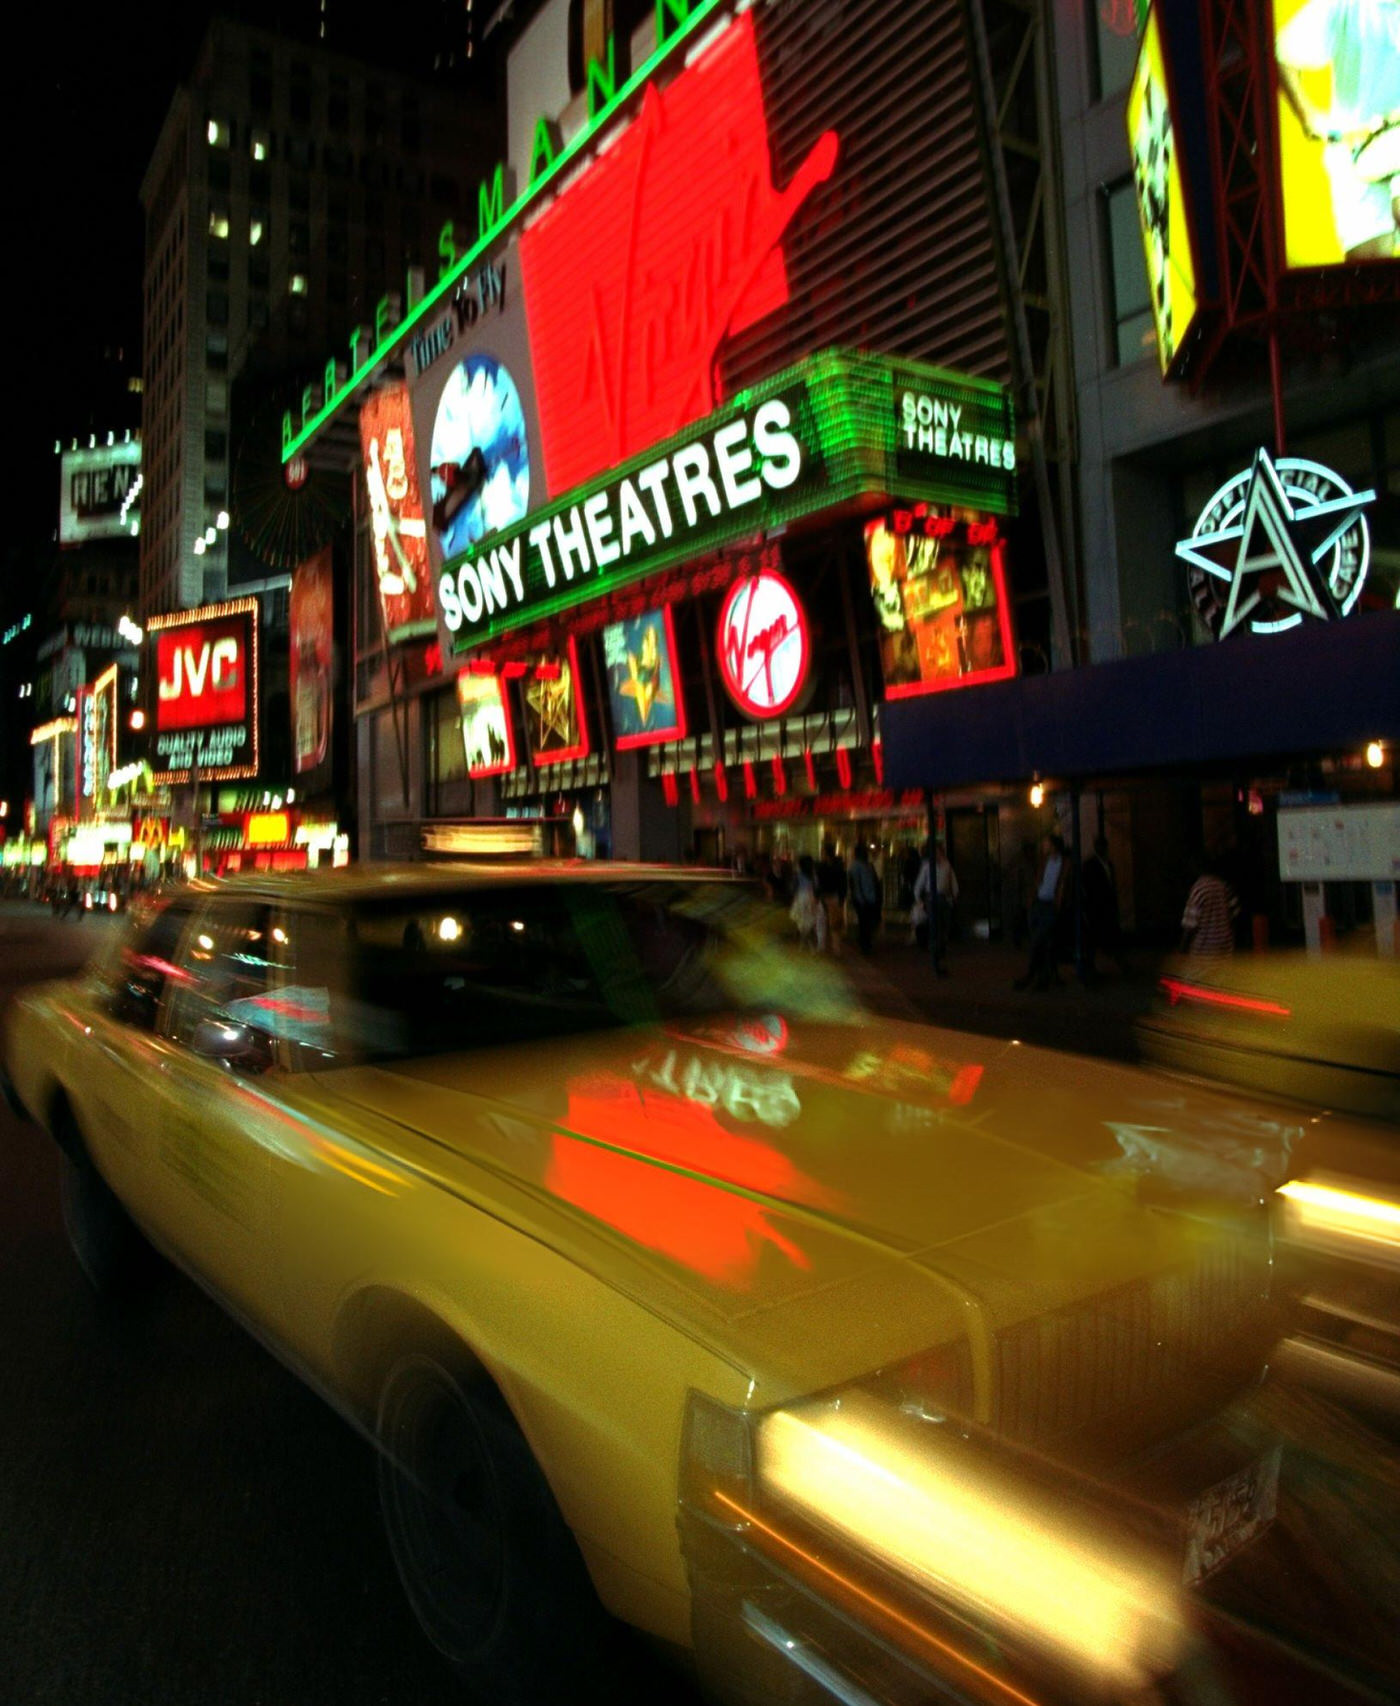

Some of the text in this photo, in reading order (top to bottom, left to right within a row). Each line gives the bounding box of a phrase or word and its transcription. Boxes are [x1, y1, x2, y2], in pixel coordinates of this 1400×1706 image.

[904, 391, 962, 428] SONY
[904, 424, 1016, 471] THEATRES
[438, 537, 525, 632] SONY
[529, 400, 801, 589] THEATRES
[728, 576, 799, 705] Virgin
[158, 636, 238, 701] JVC
[157, 725, 247, 758] QUALITY AUDIO
[197, 746, 234, 766] VIDEO
